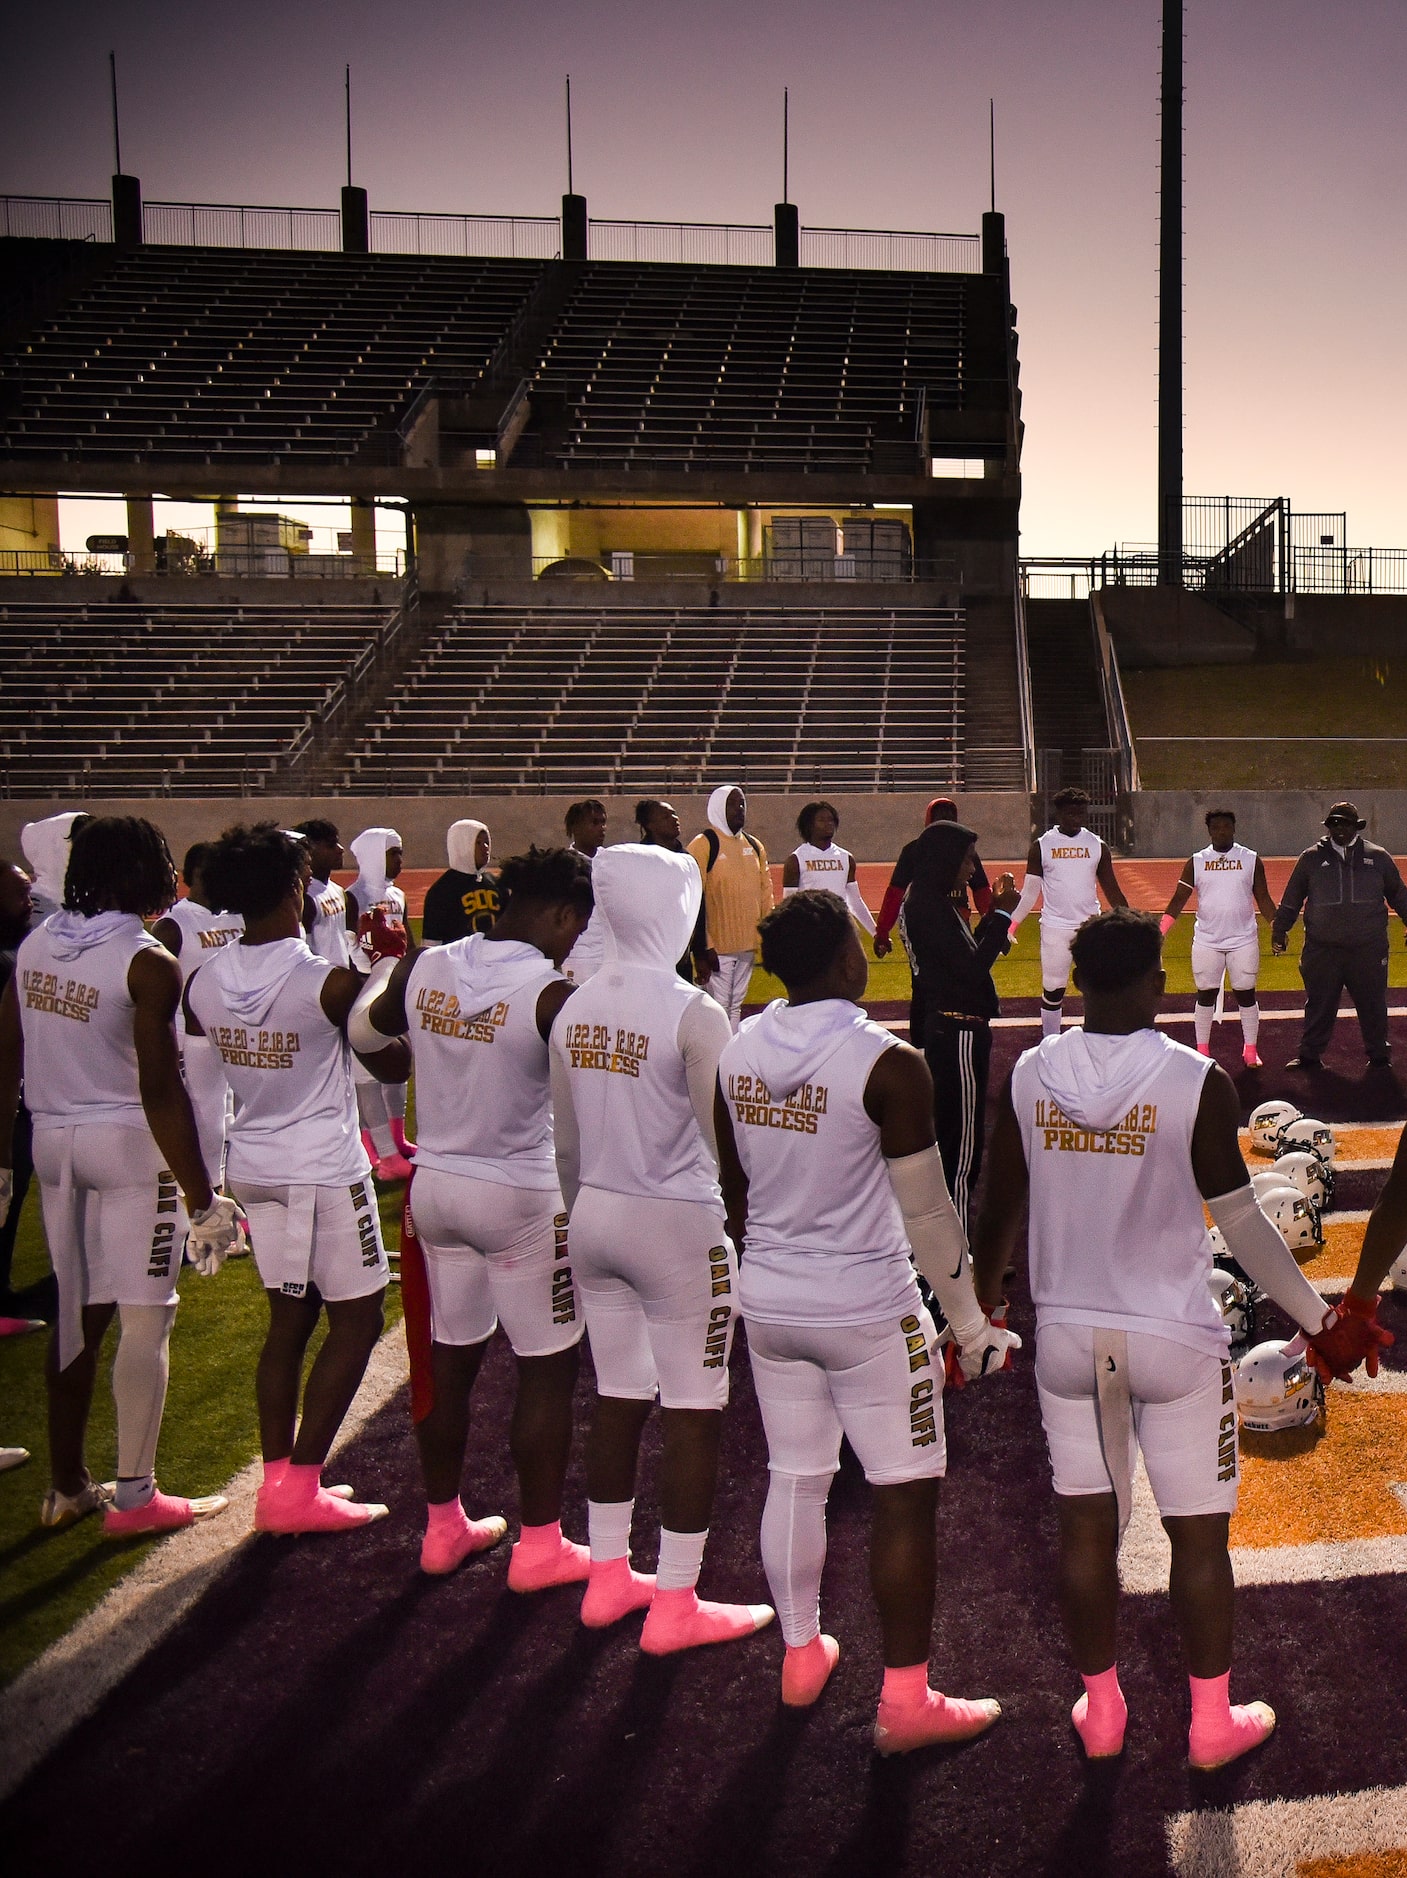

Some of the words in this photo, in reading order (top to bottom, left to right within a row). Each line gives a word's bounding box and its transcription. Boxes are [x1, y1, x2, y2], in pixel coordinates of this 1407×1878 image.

[804, 860, 844, 872] MECCA
[1050, 847, 1091, 859] MECCA
[1204, 860, 1243, 871] MECCA
[197, 928, 244, 949] MECC
[24, 969, 57, 997] 11.22.20
[65, 979, 99, 1010] 12.18.21
[26, 991, 90, 1023] PROCESS
[210, 1027, 247, 1049] 11.22.20
[258, 1031, 301, 1053] 12.18.21
[421, 1012, 496, 1043] PROCESS
[221, 1048, 293, 1069] PROCESS
[615, 1028, 650, 1060] 12.18.21
[570, 1049, 640, 1077] PROCESS
[735, 1102, 818, 1134] PROCESS
[1043, 1129, 1146, 1156] PROCESS
[157, 1170, 178, 1214] OAK
[350, 1181, 369, 1211] AK
[148, 1222, 176, 1278] CLIFF
[357, 1213, 380, 1268] CLIFF
[553, 1212, 569, 1260] OAK
[708, 1245, 732, 1298] OAK
[552, 1266, 576, 1325] CLIFF
[703, 1305, 732, 1370] CLIFF
[900, 1314, 931, 1374] OAK
[1219, 1357, 1234, 1405] AK
[909, 1378, 937, 1448] CLIFF
[1217, 1411, 1236, 1483] CLIFF
